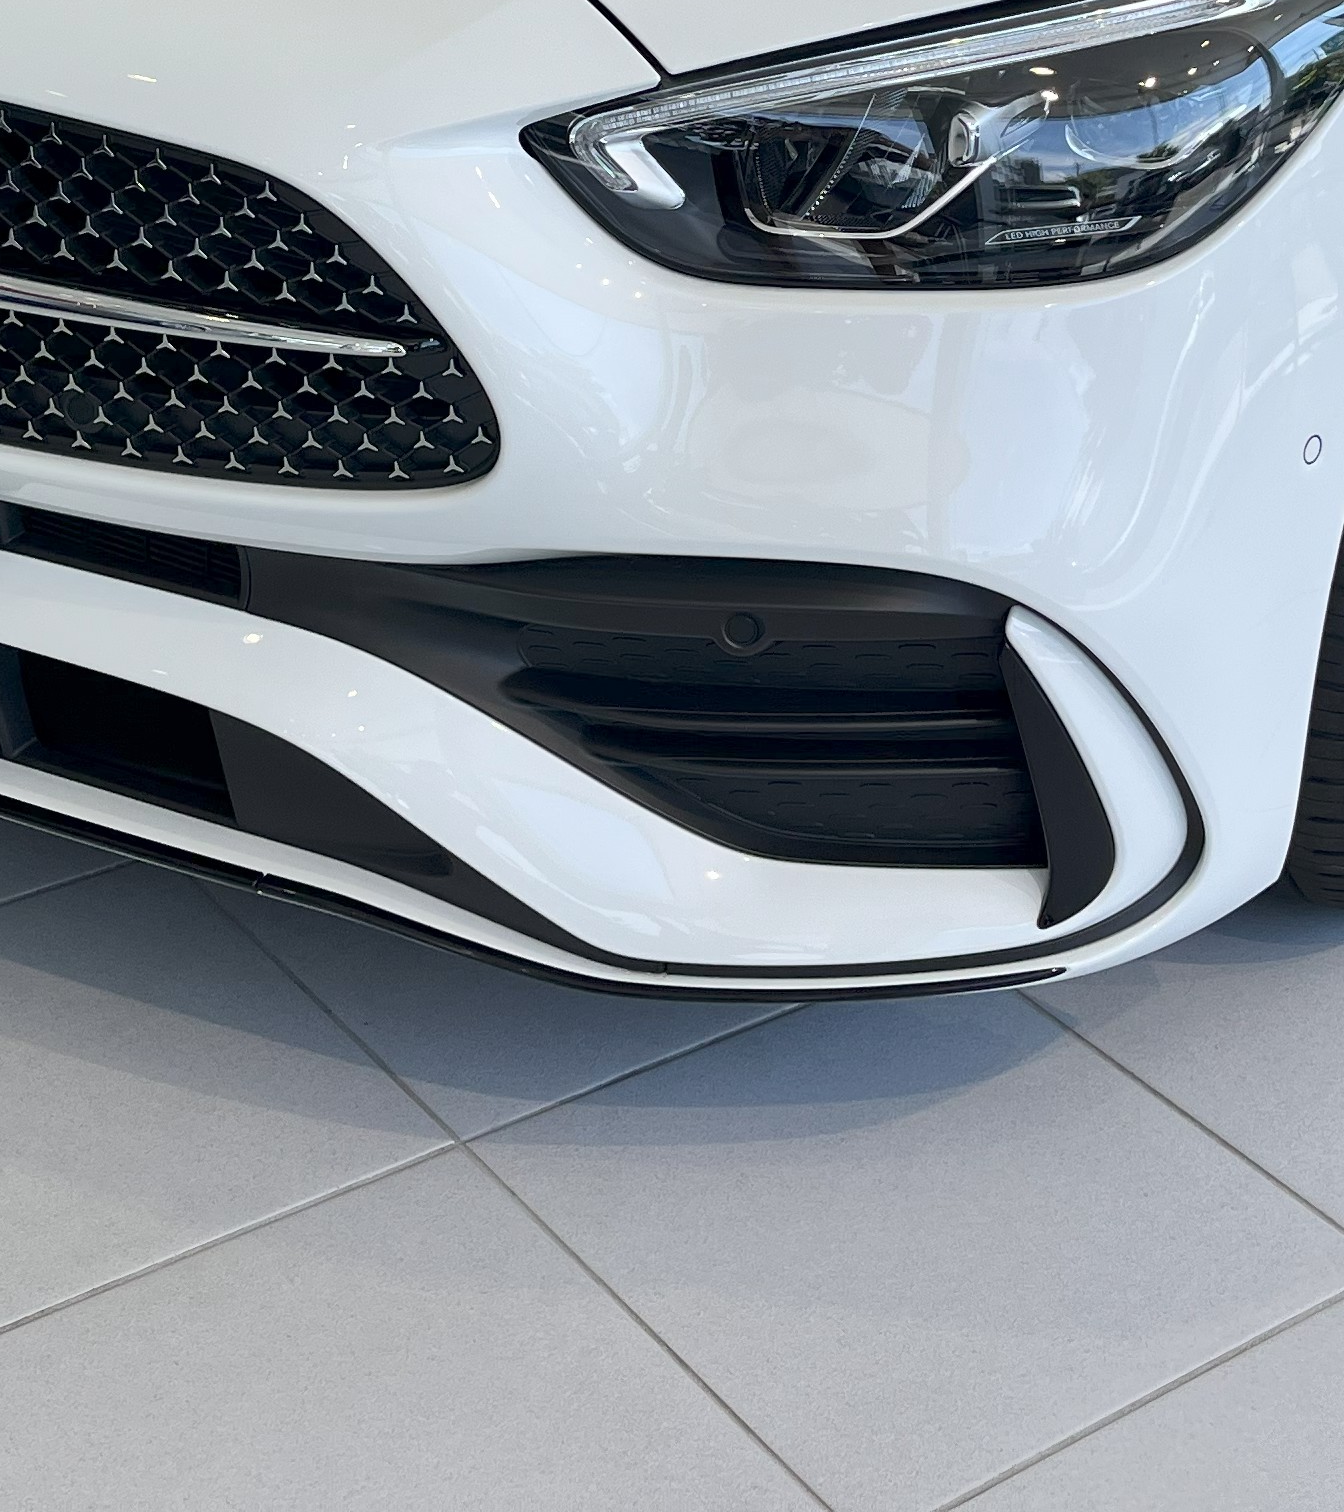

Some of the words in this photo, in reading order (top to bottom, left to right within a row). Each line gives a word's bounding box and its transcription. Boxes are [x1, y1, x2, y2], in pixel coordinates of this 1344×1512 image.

[1005, 231, 1024, 241] LED
[1025, 229, 1050, 238] HIGH
[1051, 221, 1120, 236] PERFORMANCE
